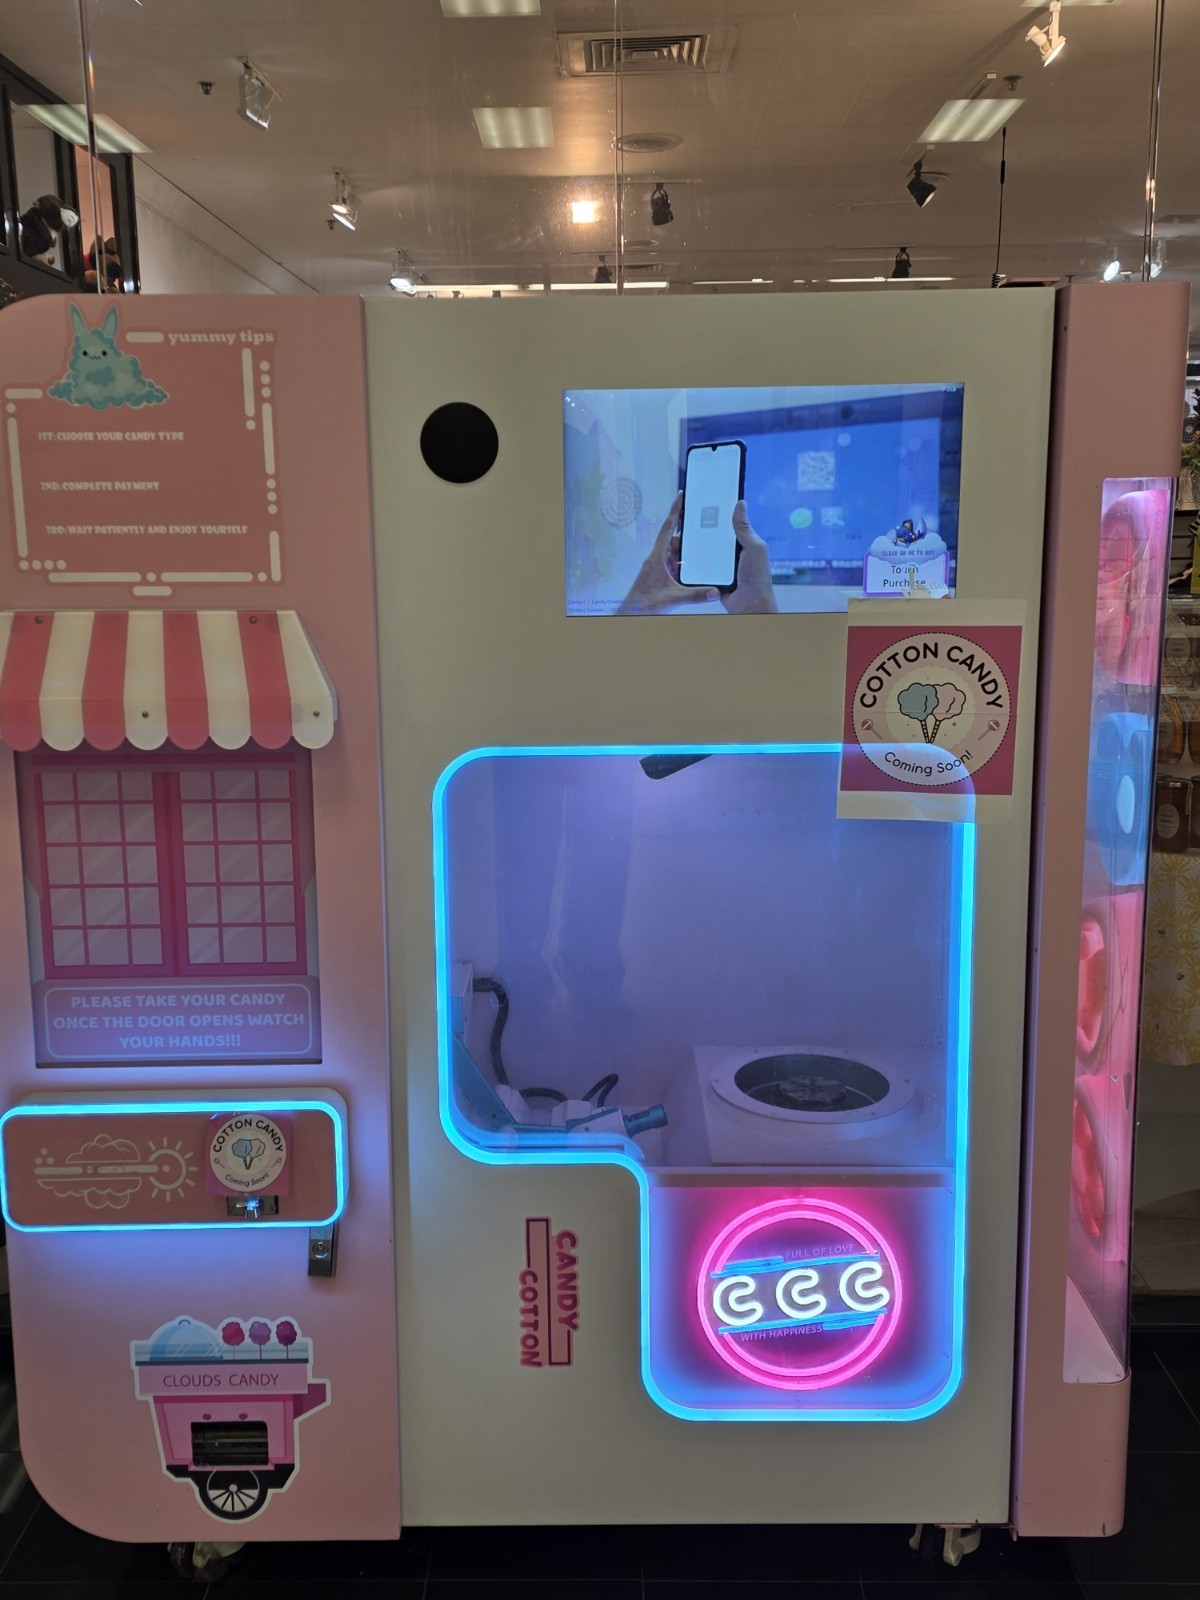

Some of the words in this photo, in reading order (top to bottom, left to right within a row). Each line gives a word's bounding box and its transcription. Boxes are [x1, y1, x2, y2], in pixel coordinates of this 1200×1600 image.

[168, 333, 236, 346] yummy
[240, 330, 274, 345] tips
[95, 432, 123, 441] YOUR
[124, 432, 156, 441] CANDY
[158, 432, 184, 441] TYPE
[114, 482, 160, 490] PAYMENT
[94, 525, 145, 534] PATIENTLY
[147, 525, 168, 534] AND
[169, 525, 198, 534] ENJOY
[200, 525, 248, 534] YOURSELF
[883, 579, 926, 588] Purchse
[860, 642, 939, 708] COTTON
[946, 646, 1003, 709] CANDY
[884, 752, 932, 776] Coming
[937, 750, 973, 773] Soon!
[71, 996, 132, 1008] PLEASE
[136, 995, 177, 1007] TAKE
[181, 994, 226, 1006] YOUR
[229, 993, 285, 1006] CANDY
[53, 1017, 98, 1029] ONCE
[102, 1016, 134, 1028] THE
[138, 1015, 186, 1028] DOOR
[189, 1014, 244, 1027] OPENS
[247, 1013, 304, 1025] WATCH
[120, 1036, 164, 1048] YOUR
[168, 1034, 241, 1047] HANDS!!!
[213, 1118, 252, 1153] COTTON
[256, 1120, 283, 1152] CANDY
[225, 1174, 250, 1187] Coming
[251, 1172, 270, 1185] Soon!
[786, 1249, 810, 1259] FULL
[812, 1247, 826, 1257] OF
[829, 1244, 855, 1254] LOVE
[556, 1231, 578, 1331] CANDY
[519, 1270, 542, 1367] COTTON
[741, 1332, 766, 1342] WITH
[769, 1326, 822, 1340] HAPPINESS
[163, 1375, 221, 1388] CLOUDS
[228, 1374, 279, 1387] CANDY
